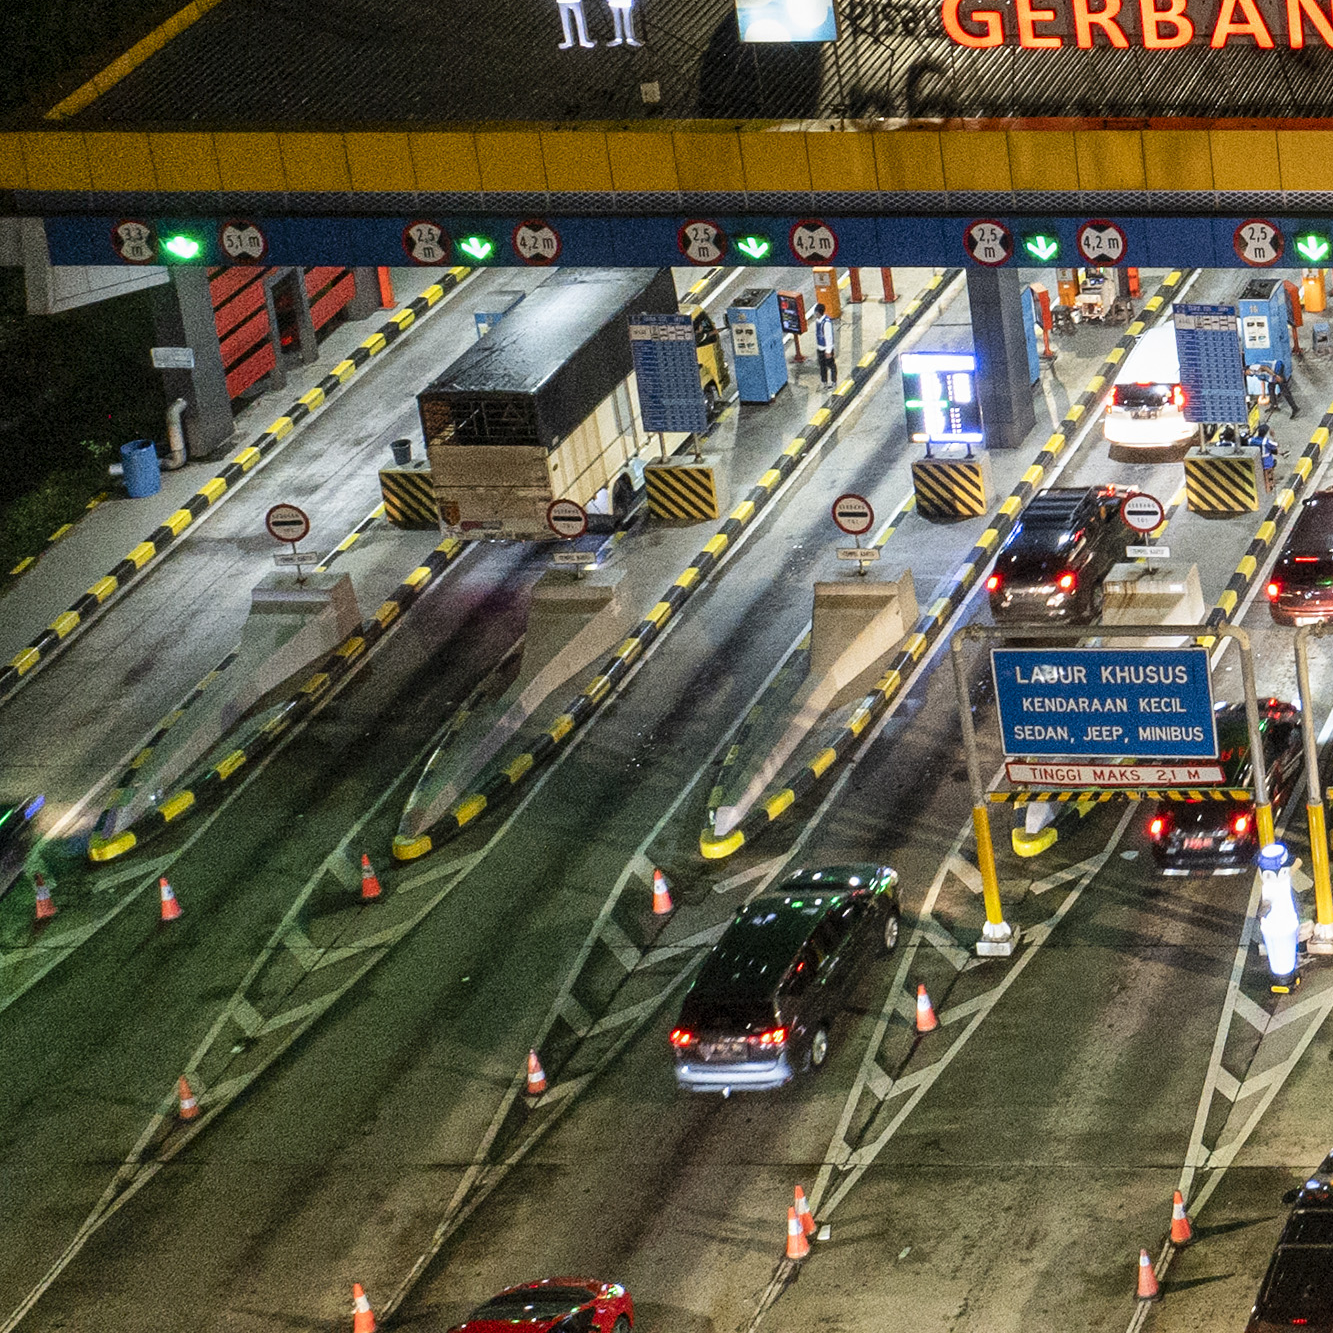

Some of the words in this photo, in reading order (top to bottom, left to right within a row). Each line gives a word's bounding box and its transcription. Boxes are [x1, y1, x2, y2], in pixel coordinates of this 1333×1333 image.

[226, 235, 242, 249] 5,1
[249, 236, 260, 247] m
[692, 228, 710, 243] 2,5
[978, 228, 997, 243] 2,5
[1248, 228, 1267, 242] 2,5
[519, 236, 537, 251] 4,2
[543, 238, 554, 248] m
[797, 236, 815, 250] 4,2
[820, 238, 830, 248] m
[1084, 236, 1102, 250] 4,2
[1108, 238, 1119, 248] m
[423, 246, 435, 257] m
[698, 247, 709, 257] m
[985, 247, 995, 258] m
[1254, 248, 1265, 258] m
[1016, 665, 1087, 683] LAJUR
[1102, 666, 1188, 684] KHUSUS
[1022, 698, 1127, 712] KENDARAAN
[1139, 699, 1186, 713] KECIL
[1014, 726, 1075, 743] SEDAN,
[1083, 727, 1129, 743] JEEP,
[1138, 727, 1204, 742] MINIBUS
[1029, 768, 1082, 781] TINGGI
[1157, 770, 1176, 784] 2,1
[1188, 770, 1200, 780] M
